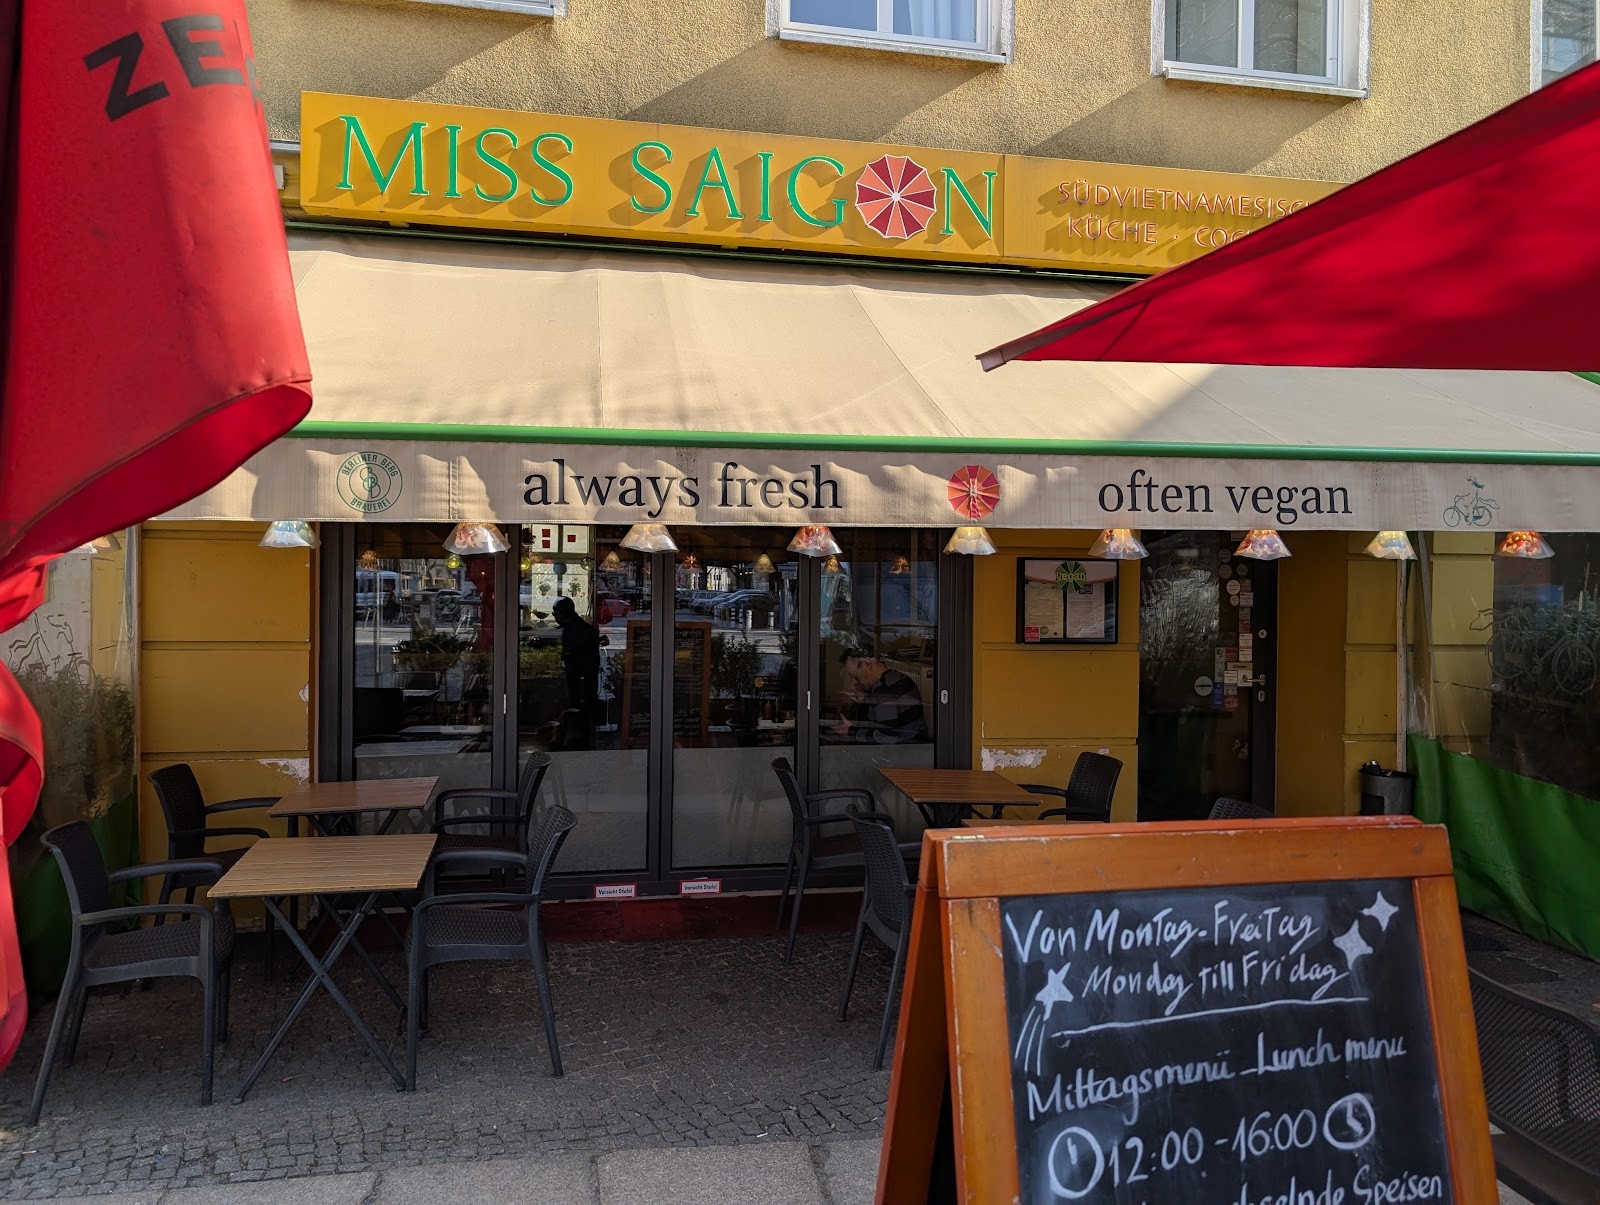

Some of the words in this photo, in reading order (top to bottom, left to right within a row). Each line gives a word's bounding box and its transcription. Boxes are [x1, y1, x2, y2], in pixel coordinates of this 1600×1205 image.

[83, 14, 262, 122] ZE
[335, 114, 575, 207] MISS
[1057, 178, 1311, 219] SÜDVIETNAMESISC
[1067, 213, 1158, 244] KÜCHE
[341, 454, 378, 476] BERLINER
[380, 458, 399, 477] BERG
[523, 459, 700, 518] always
[717, 461, 843, 509] fresh
[350, 497, 391, 512] BRAUEREI
[1098, 469, 1214, 513] often
[1225, 484, 1353, 525] vegan
[1055, 571, 1087, 583] vegan
[1005, 909, 1077, 963] Von
[1027, 1050, 1236, 1126] Mittagsmenü
